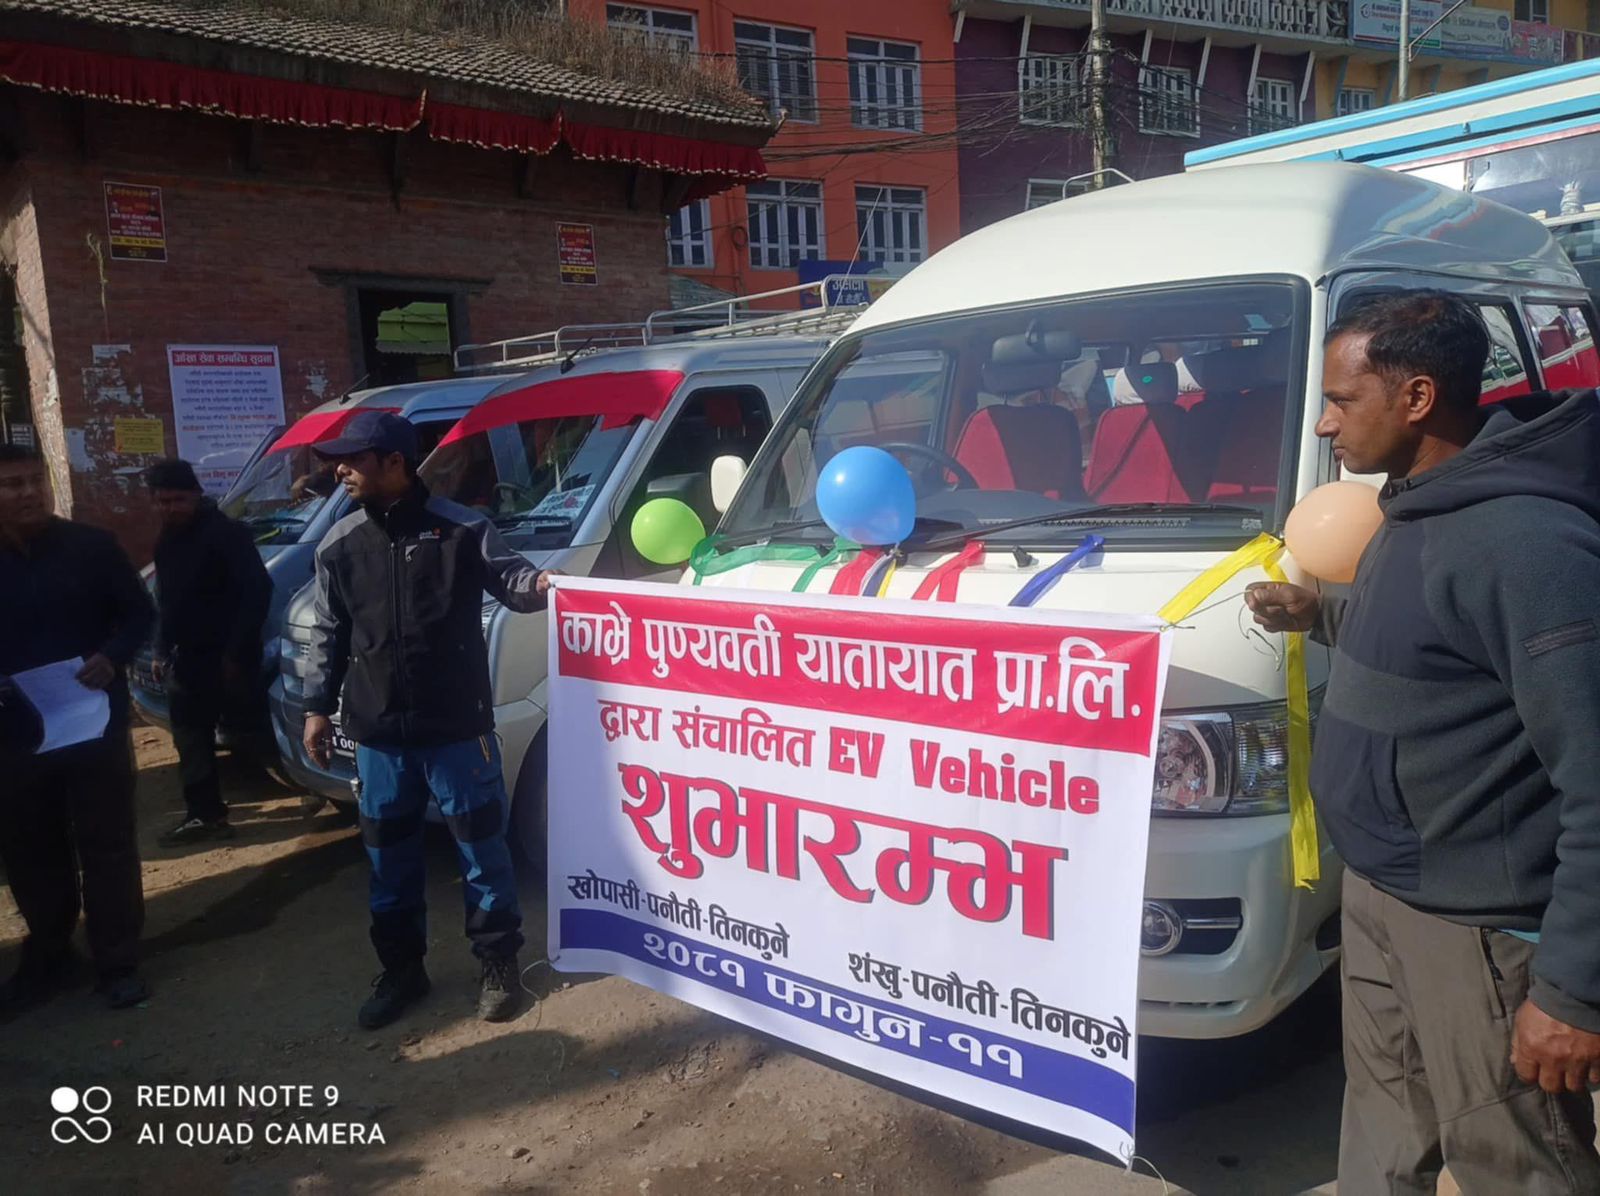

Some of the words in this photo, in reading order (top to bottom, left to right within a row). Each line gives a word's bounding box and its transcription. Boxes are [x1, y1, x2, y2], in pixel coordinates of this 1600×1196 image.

[561, 601, 631, 668] काभ्रे
[642, 613, 781, 680] पुण्यवती
[793, 633, 977, 702] यातायात
[599, 699, 661, 743] द्वारा
[672, 705, 815, 767] संचालित
[829, 726, 885, 779] EV
[910, 738, 1100, 816] Vehicle
[617, 762, 1069, 941] शुभारम्भ
[642, 931, 746, 988] २०८१
